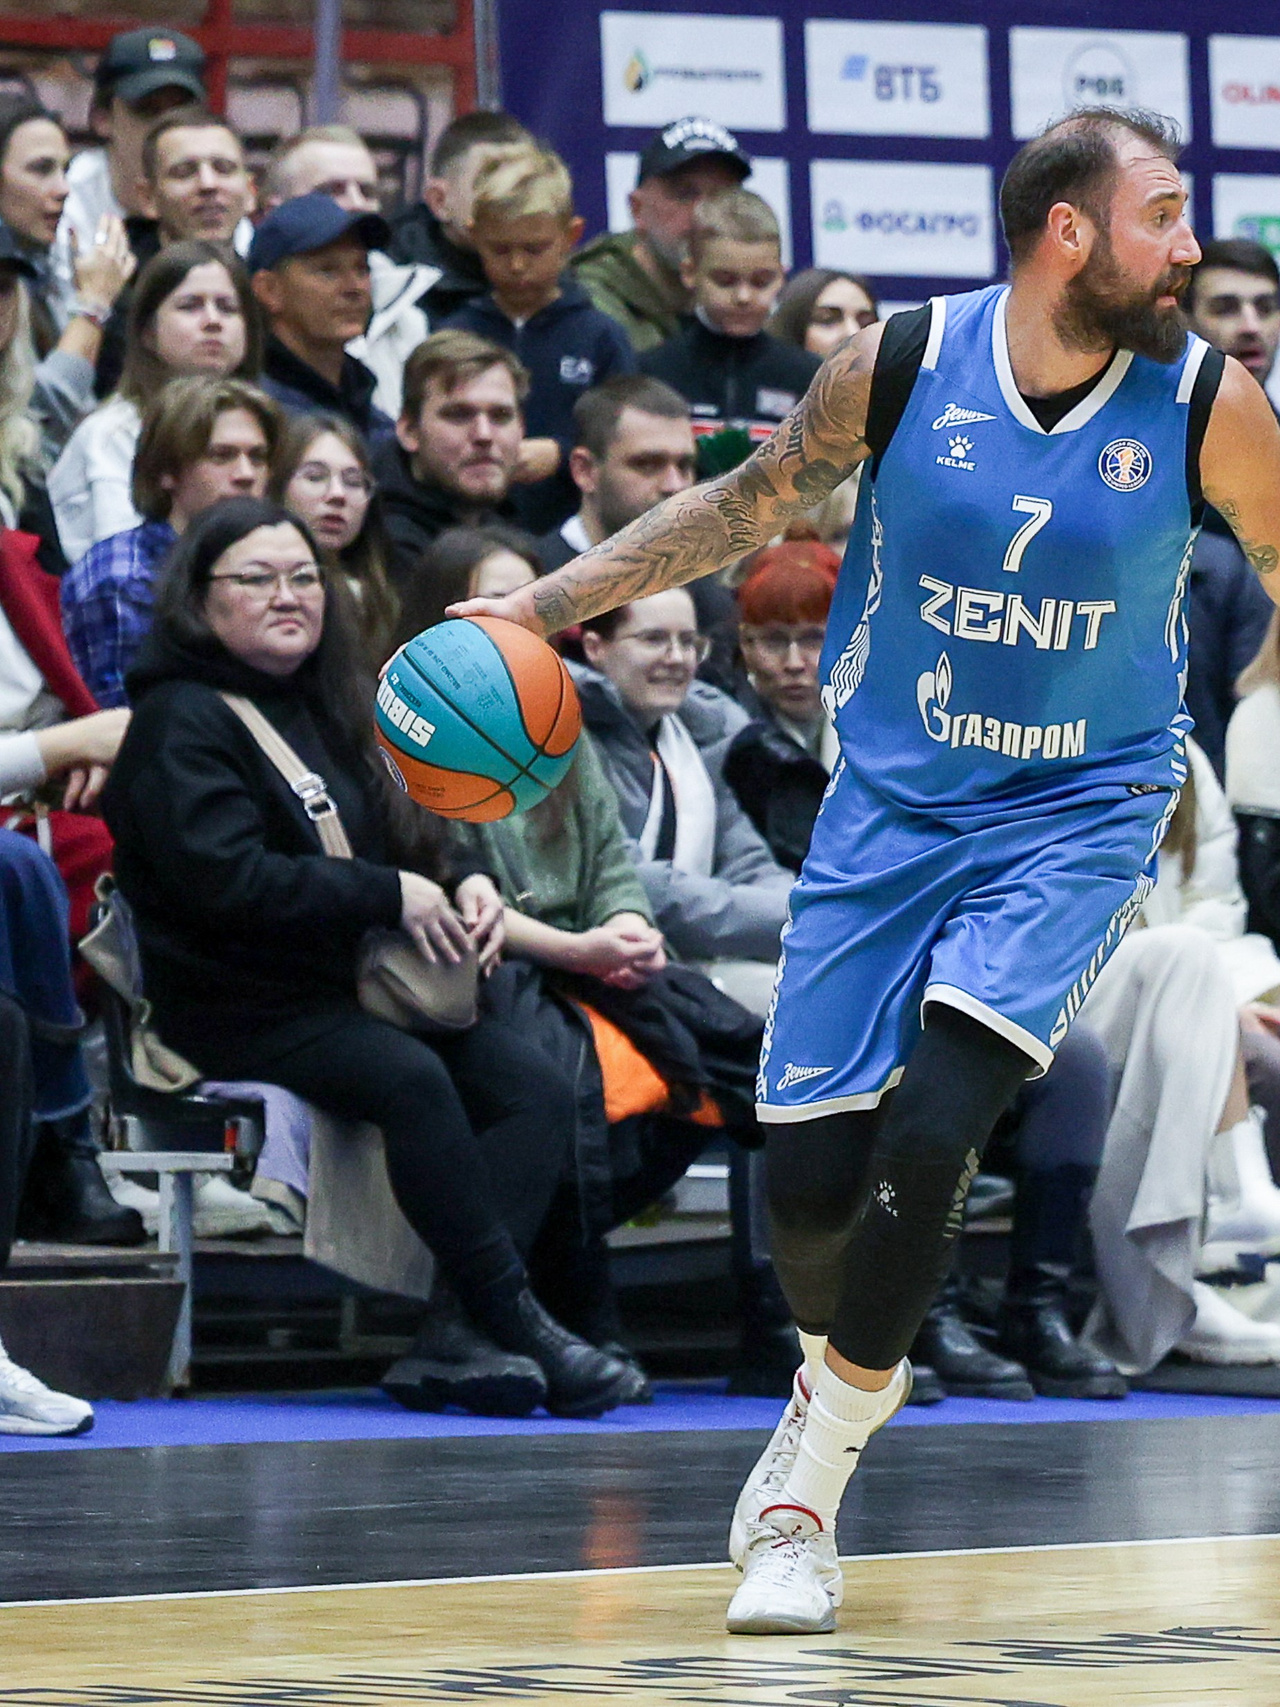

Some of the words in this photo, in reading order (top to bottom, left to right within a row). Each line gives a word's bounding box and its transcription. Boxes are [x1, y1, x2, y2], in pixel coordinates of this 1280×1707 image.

[873, 65, 942, 105] ВТБ
[936, 455, 976, 472] KELME
[1002, 494, 1053, 573] 7
[917, 574, 1117, 651] ZENIT
